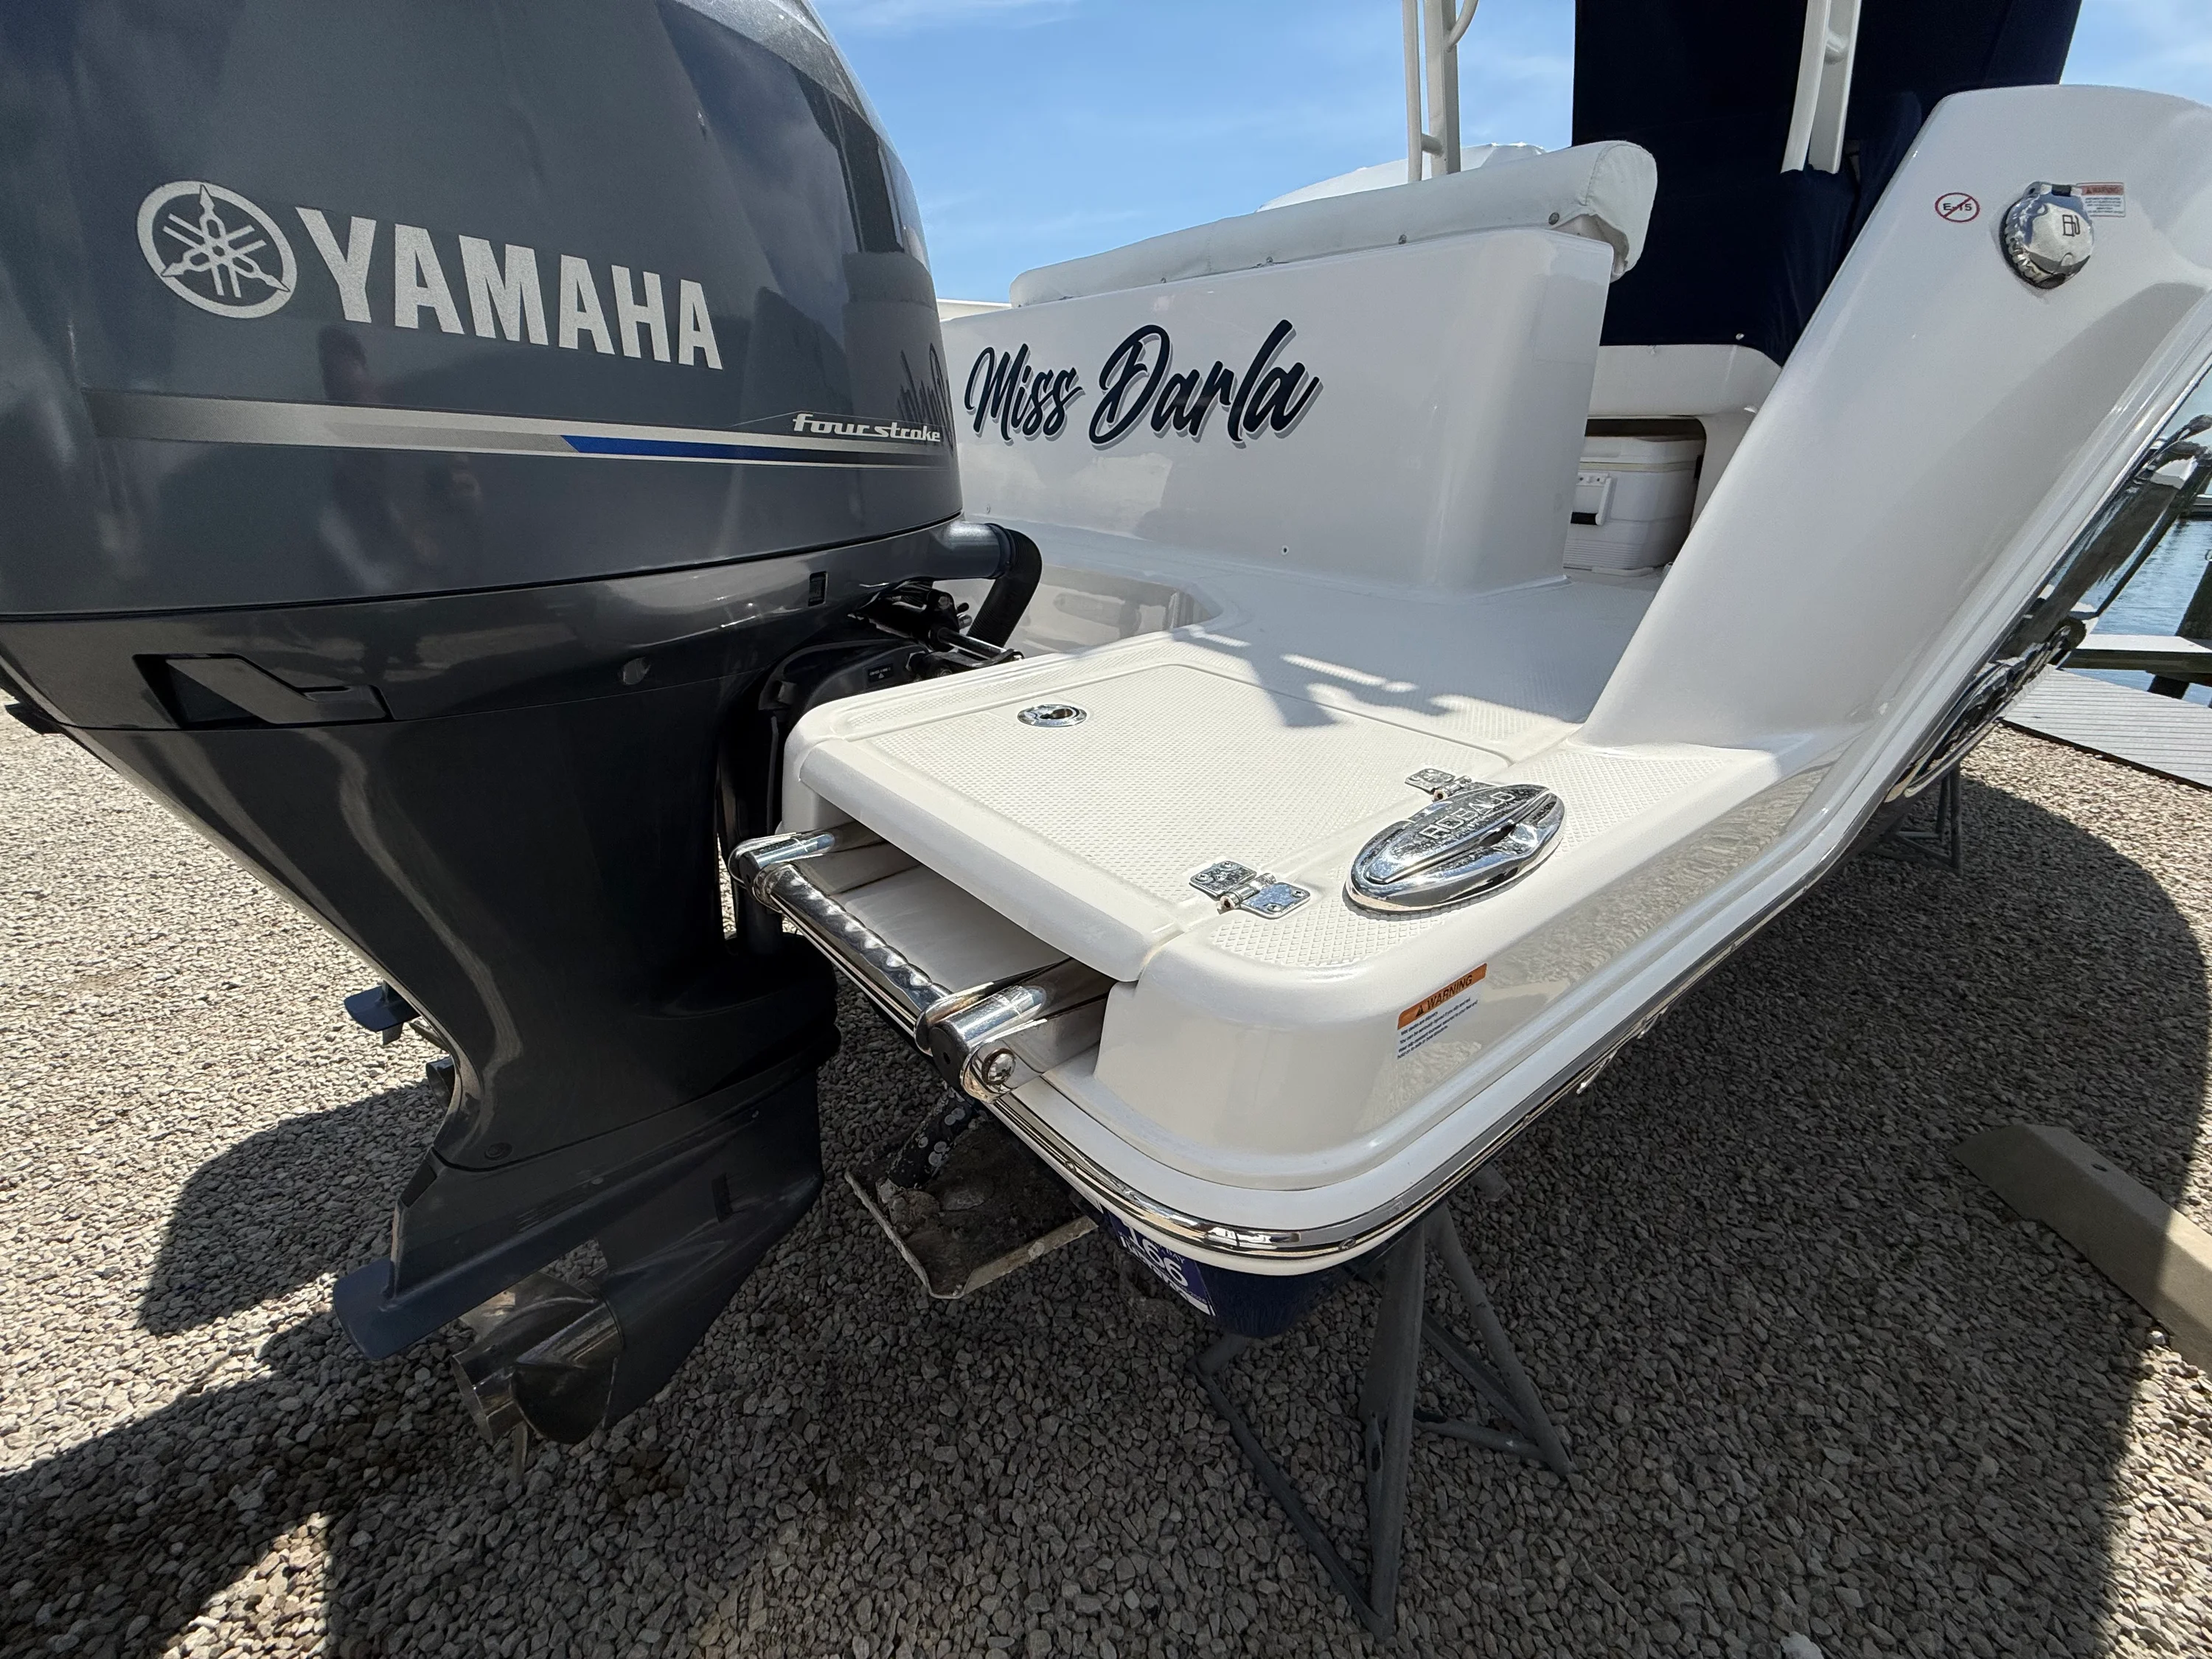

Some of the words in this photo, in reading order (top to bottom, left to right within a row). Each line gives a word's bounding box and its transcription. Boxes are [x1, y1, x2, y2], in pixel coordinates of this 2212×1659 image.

[1943, 203, 1972, 212] E-15
[295, 206, 723, 371] YAMAHA
[964, 343, 1085, 445] Miss
[1089, 319, 1323, 449] Darla
[1427, 974, 1472, 1010] WARNING
